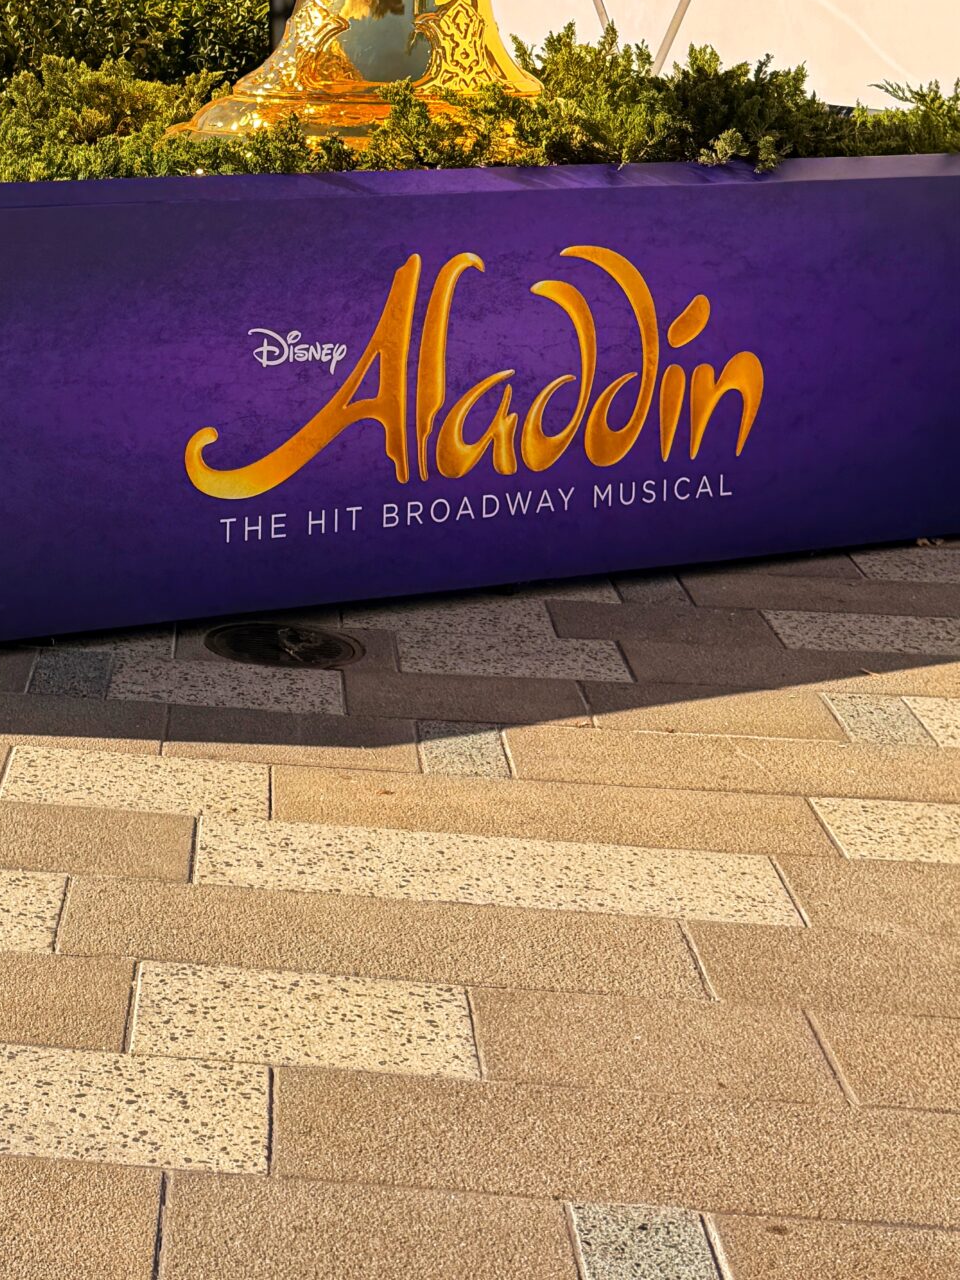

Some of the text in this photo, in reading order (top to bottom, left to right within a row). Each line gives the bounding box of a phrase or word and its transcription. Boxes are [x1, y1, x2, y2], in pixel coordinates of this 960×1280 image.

[185, 245, 764, 499] Aladdin
[220, 474, 733, 543] THE HIT BROADWAY MUSICAL
